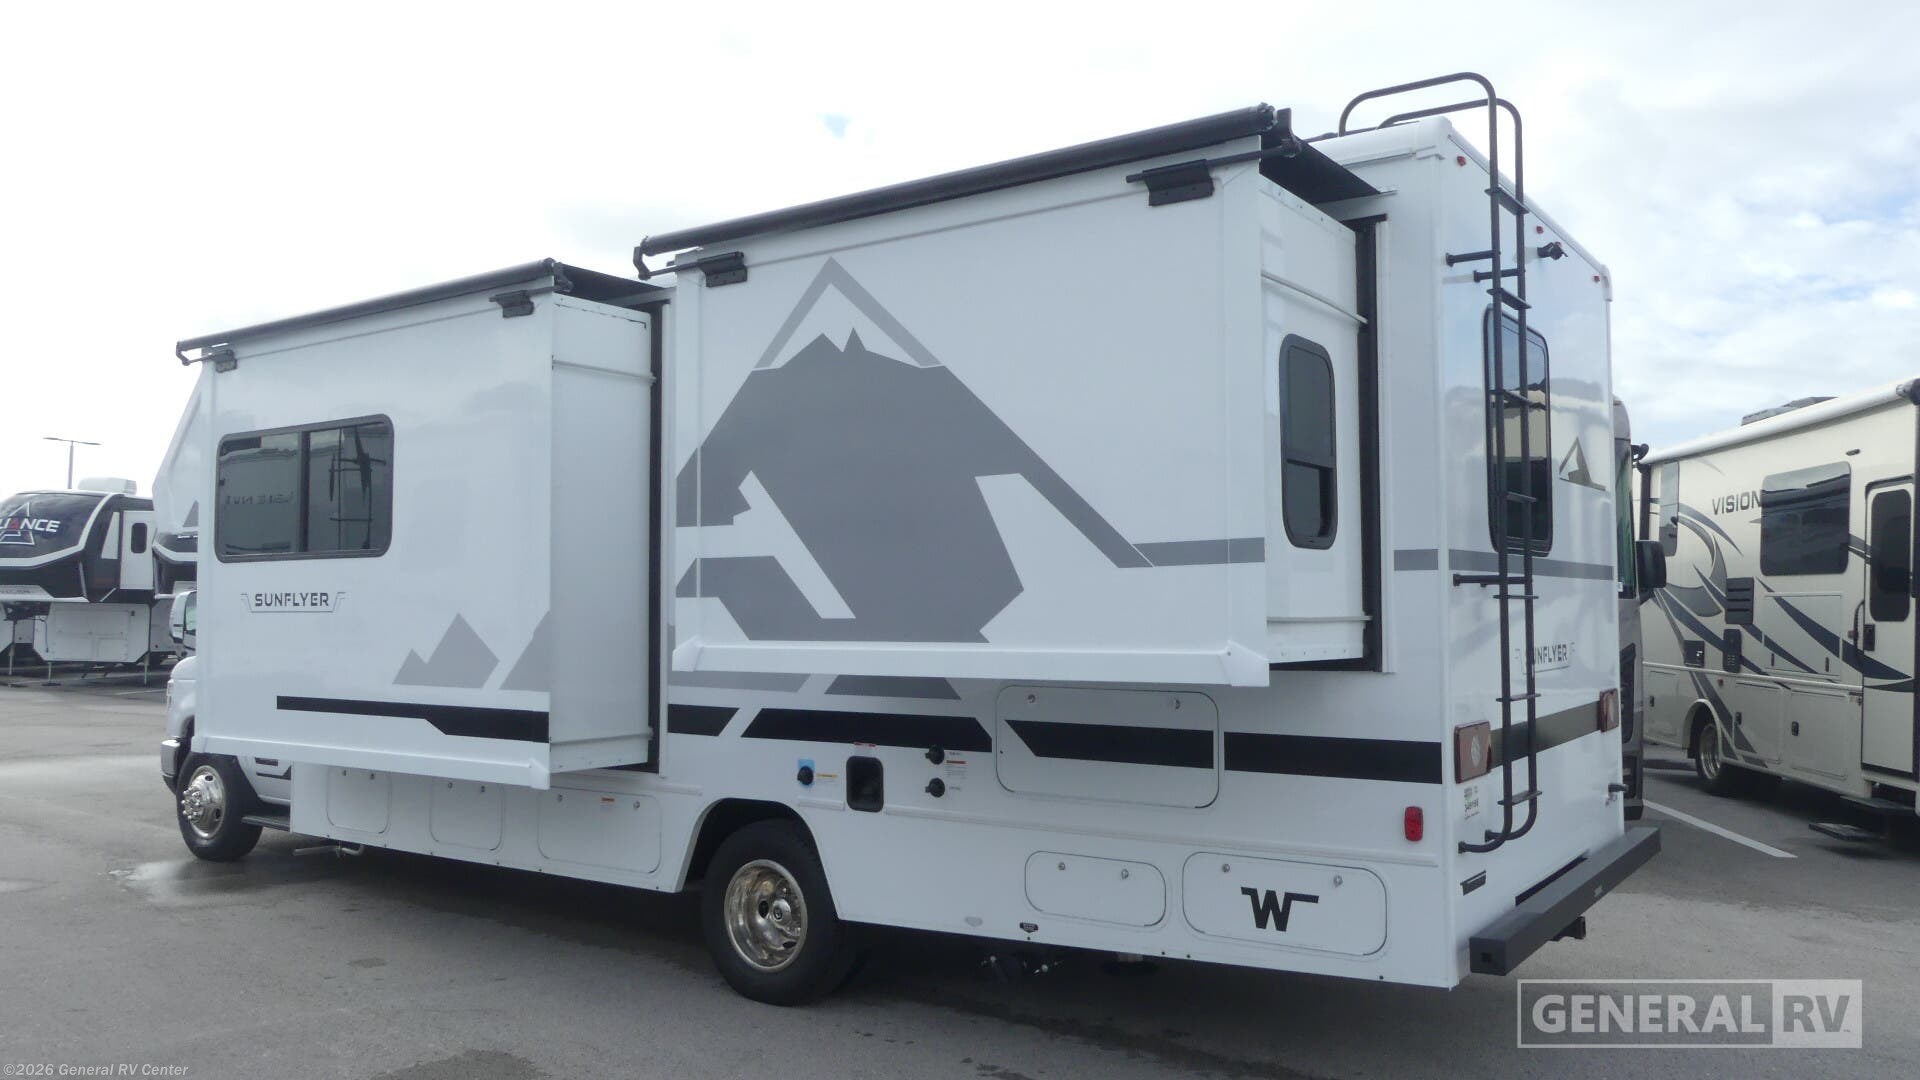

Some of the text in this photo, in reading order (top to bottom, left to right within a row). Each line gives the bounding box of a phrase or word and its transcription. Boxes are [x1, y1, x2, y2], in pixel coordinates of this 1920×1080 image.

[1711, 490, 1761, 515] VISION
[254, 592, 329, 607] SUNFLYER
[1533, 643, 1568, 665] NFLYER
